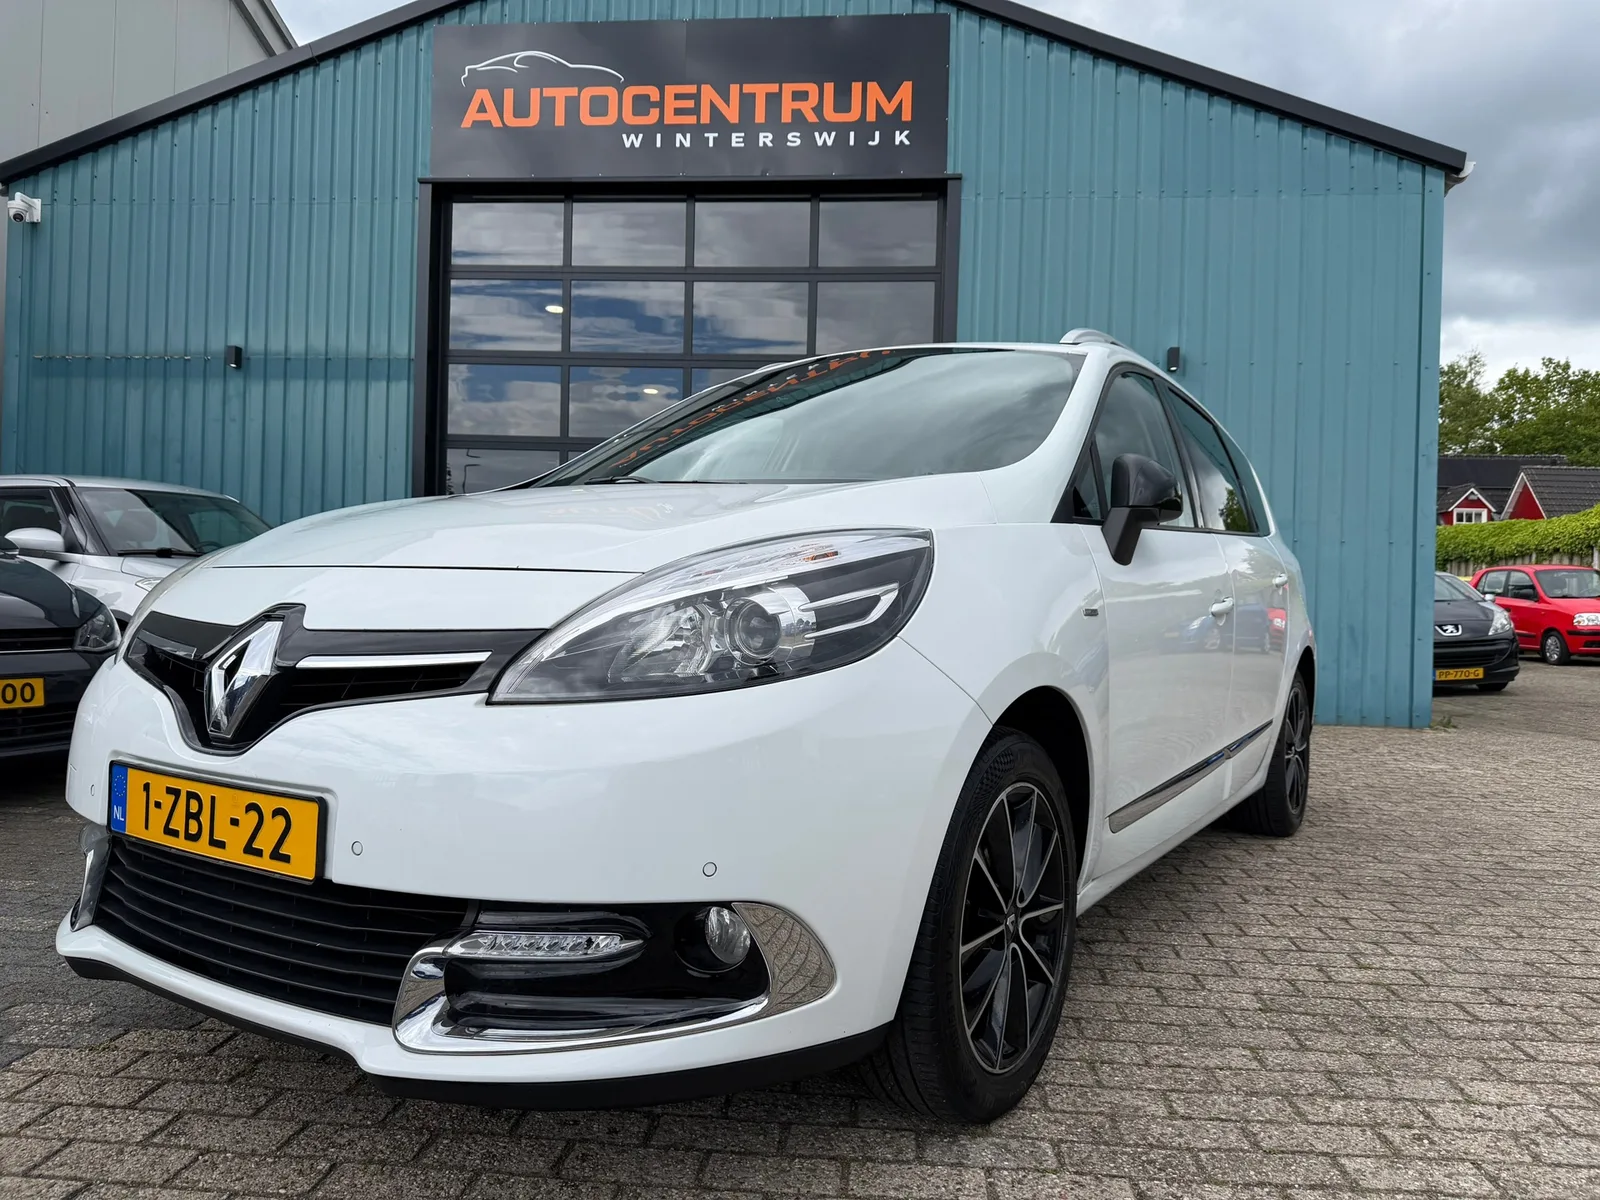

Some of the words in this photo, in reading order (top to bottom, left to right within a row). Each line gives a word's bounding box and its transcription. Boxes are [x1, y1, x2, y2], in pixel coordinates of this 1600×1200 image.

[461, 81, 913, 128] AUTOCENTRUM
[622, 130, 911, 148] WINTERSWIJK
[1438, 670, 1480, 679] PP-770-G
[113, 804, 125, 822] NL
[142, 781, 292, 864] 1-ZBL-22
